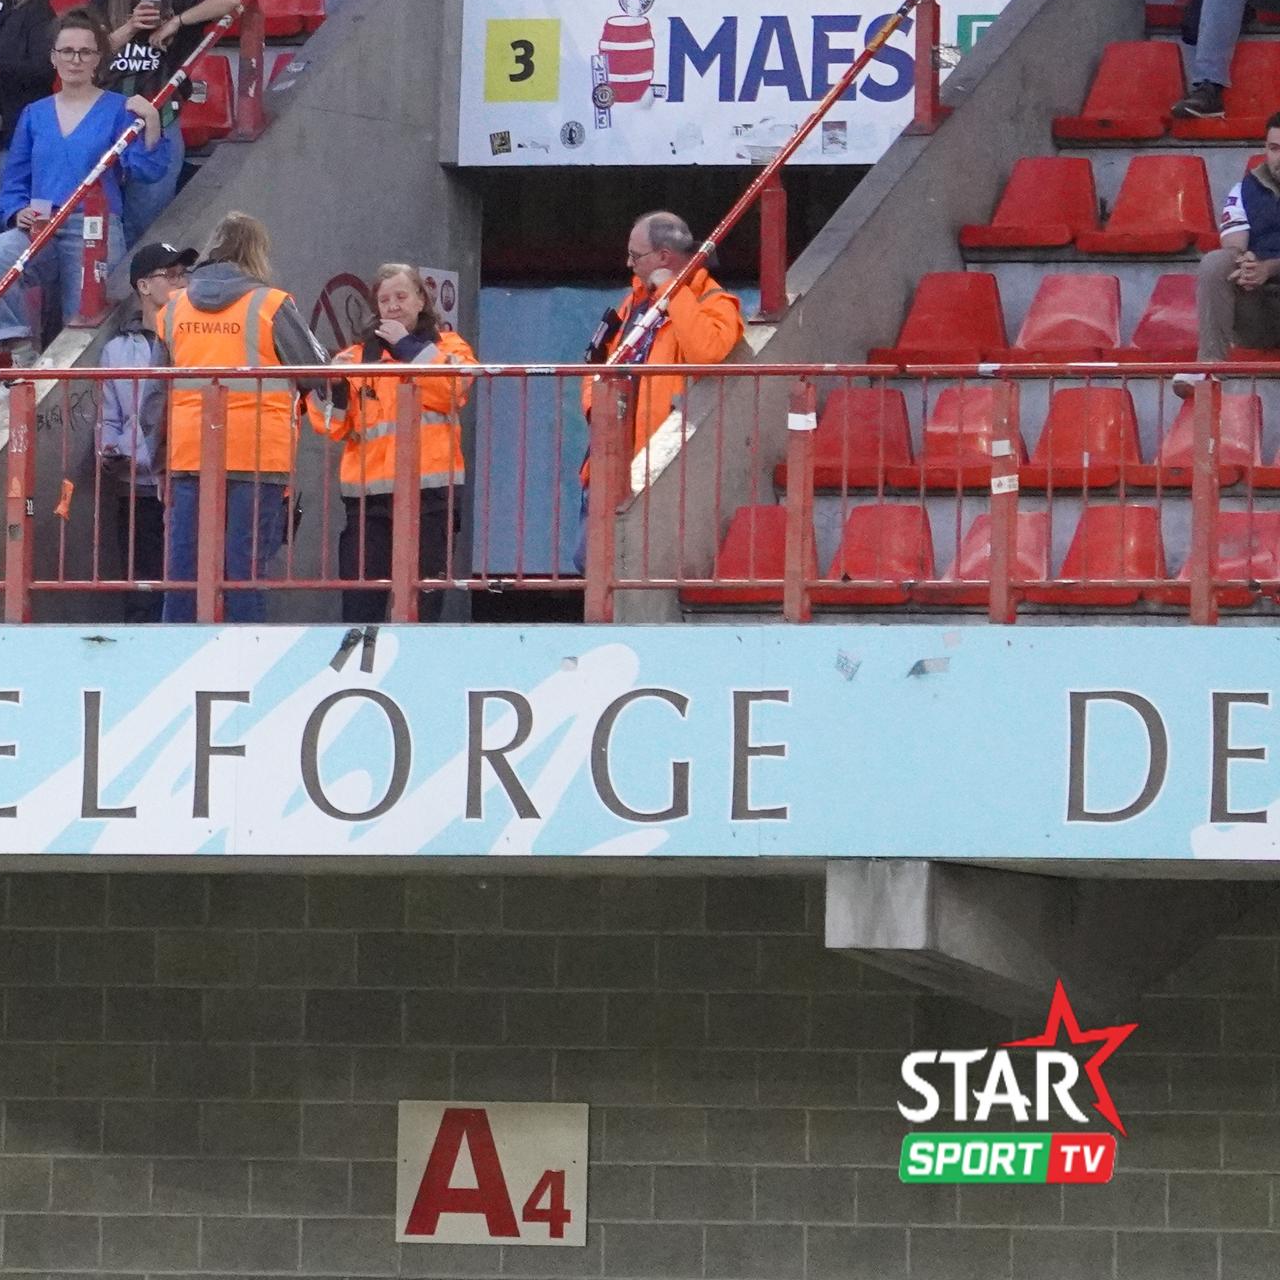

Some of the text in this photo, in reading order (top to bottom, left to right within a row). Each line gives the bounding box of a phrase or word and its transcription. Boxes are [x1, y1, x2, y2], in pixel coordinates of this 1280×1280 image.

[509, 39, 536, 83] 3
[667, 14, 917, 103] MAES
[178, 322, 241, 335] STEWARD
[1066, 689, 1271, 825] DE
[404, 1107, 572, 1240] A4
